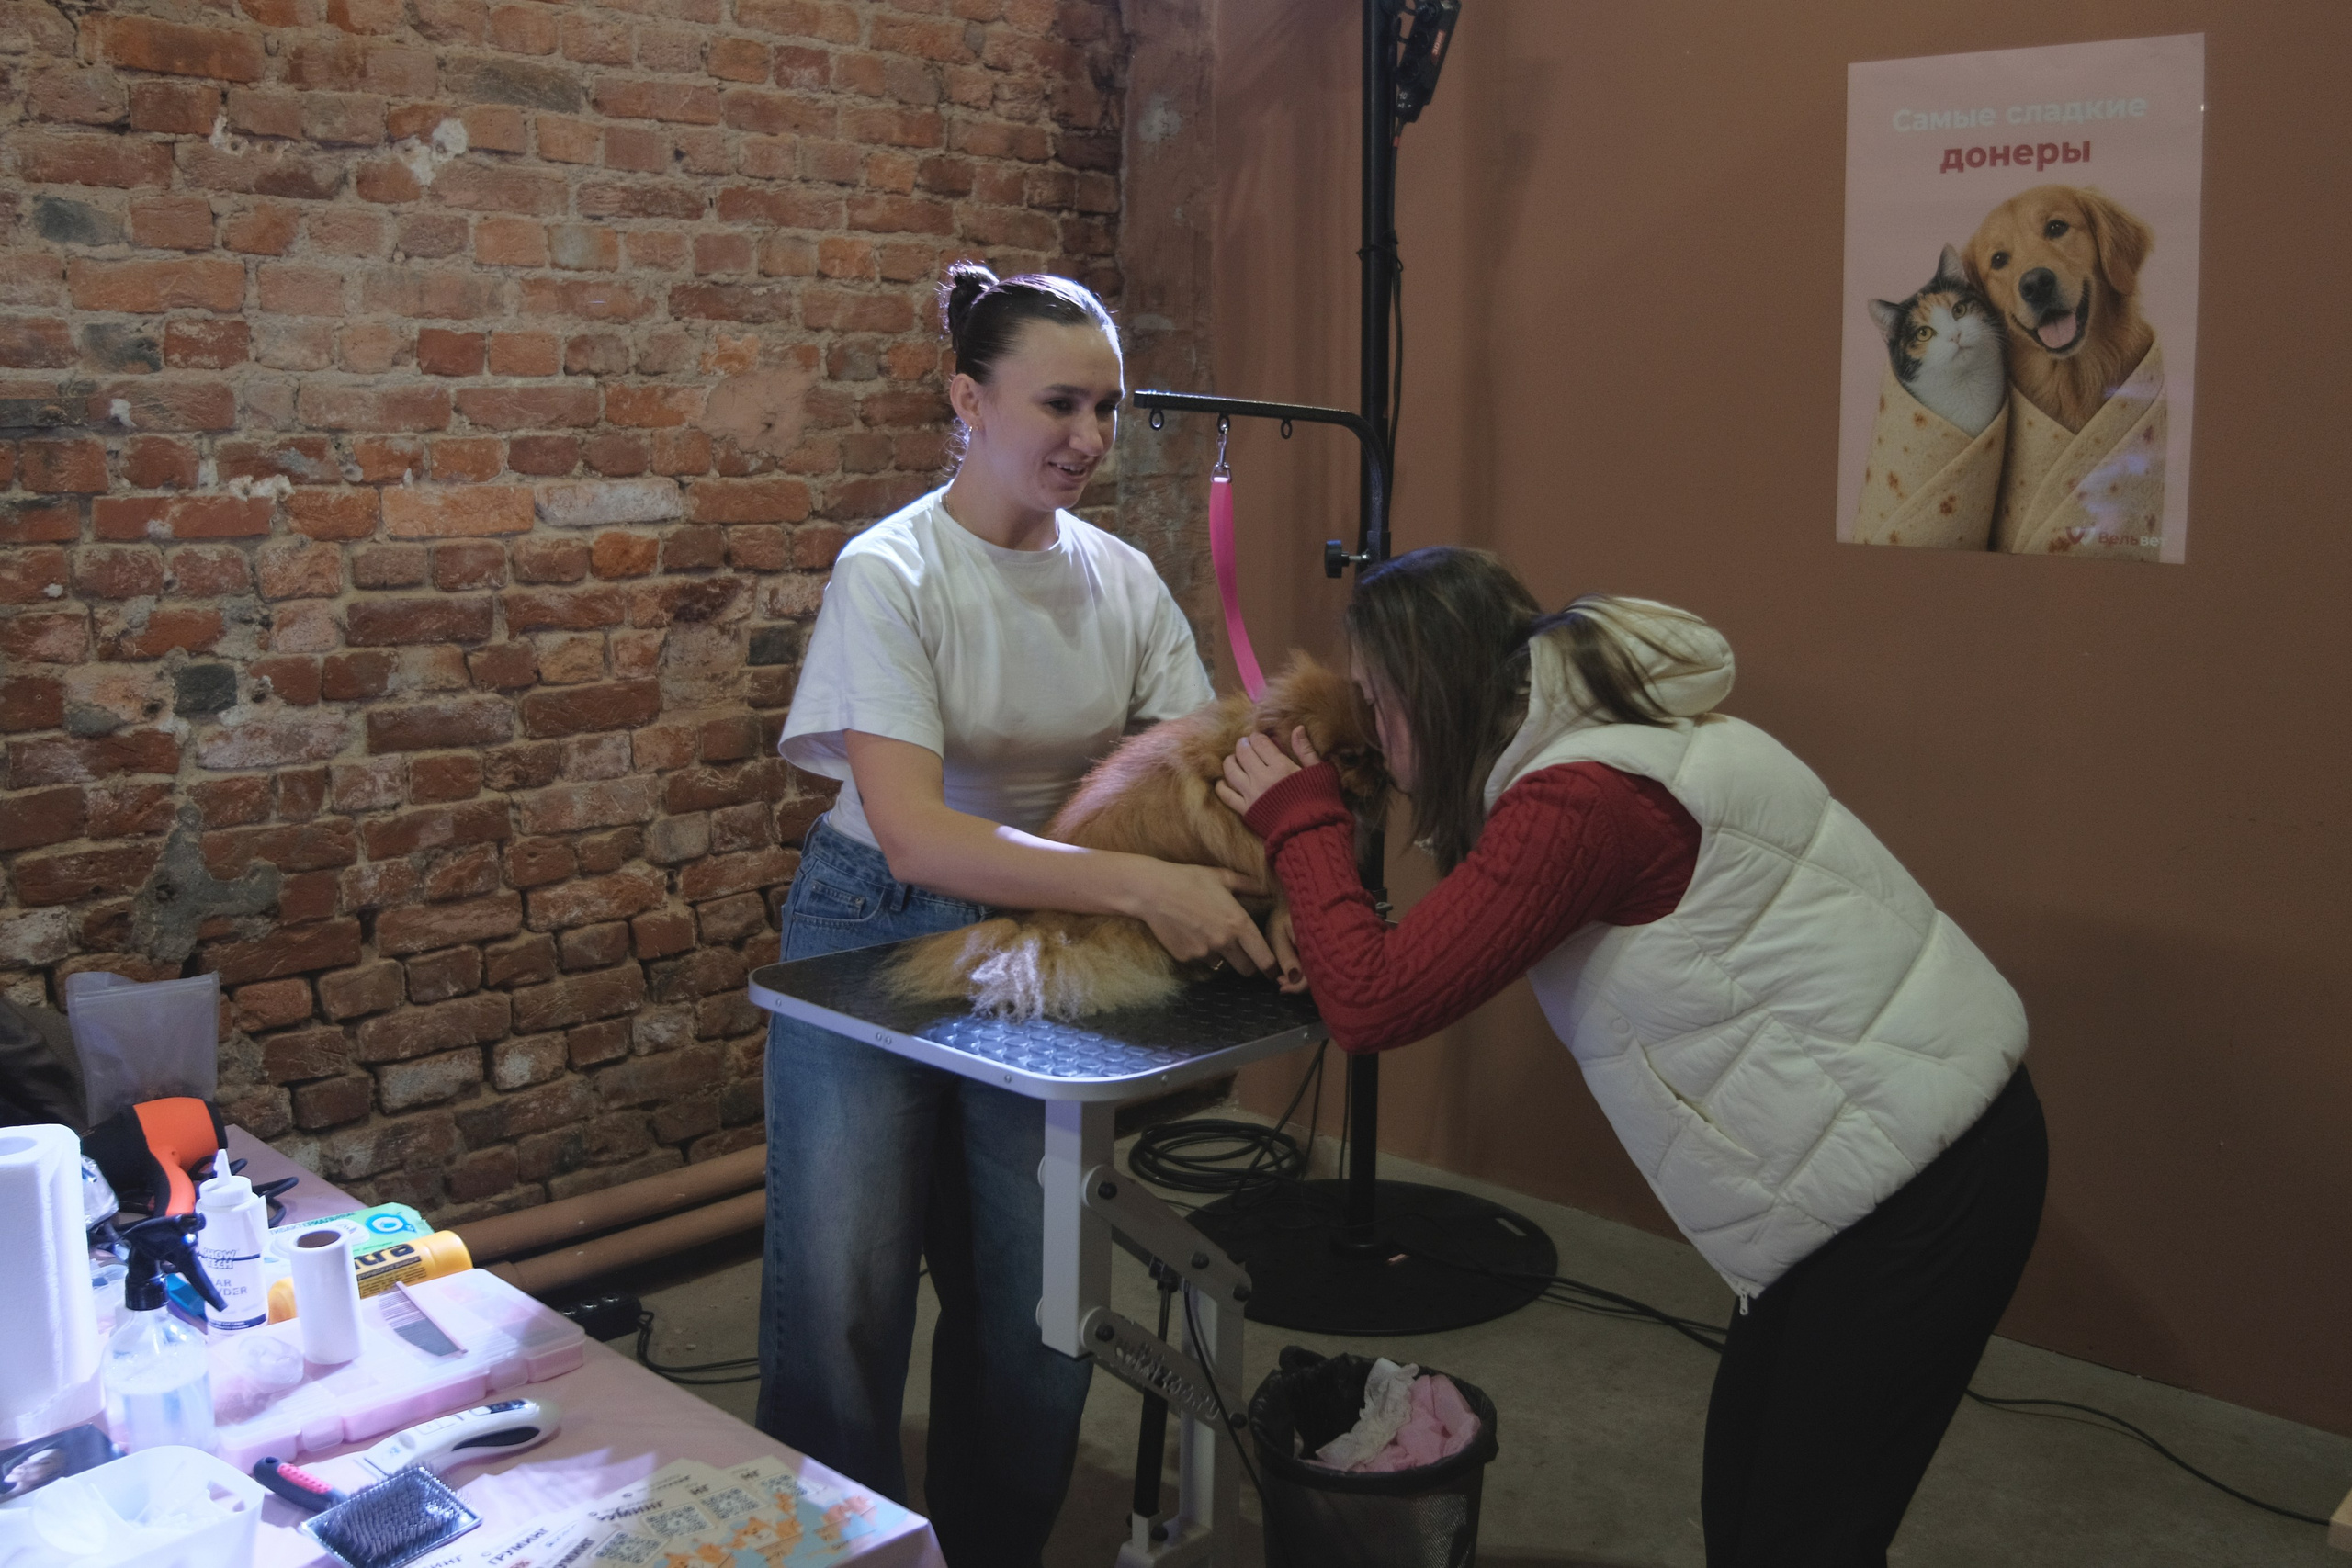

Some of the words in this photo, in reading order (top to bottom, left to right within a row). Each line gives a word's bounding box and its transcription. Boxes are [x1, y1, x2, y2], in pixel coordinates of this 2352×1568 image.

[1892, 106, 1996, 133] Самые
[2005, 96, 2149, 125] сладкие
[1939, 140, 2091, 174] донеры
[2098, 530, 2168, 547] Вельвет
[212, 1278, 232, 1287] AR
[487, 1526, 549, 1565] ГРУМИНГ
